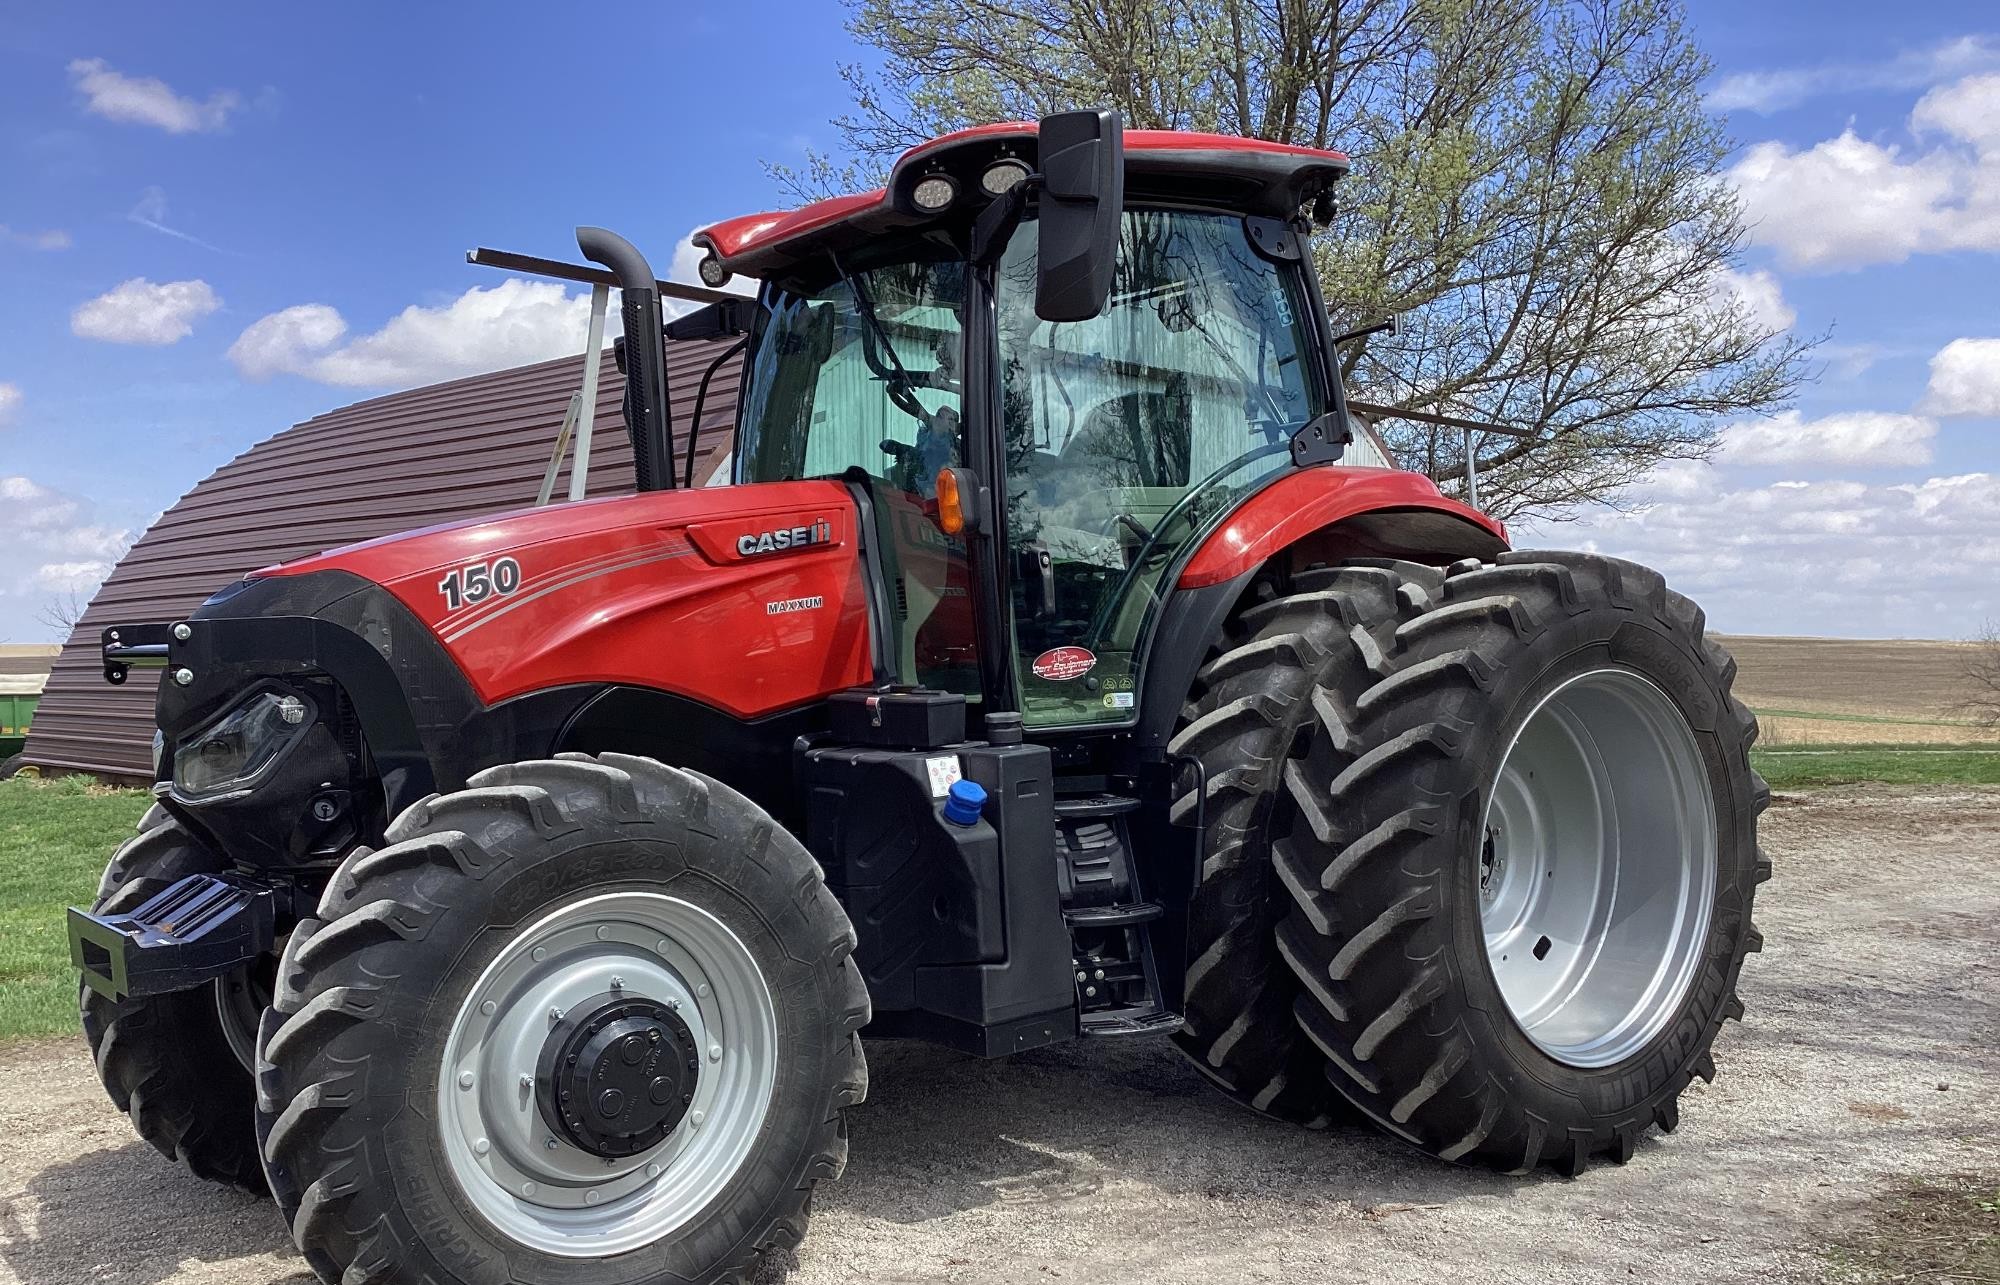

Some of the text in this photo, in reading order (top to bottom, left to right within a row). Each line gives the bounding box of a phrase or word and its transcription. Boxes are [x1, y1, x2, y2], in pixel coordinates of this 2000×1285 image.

[737, 526, 807, 555] CASE
[438, 556, 521, 612] 150
[767, 596, 823, 615] MAXXUM
[1600, 961, 1725, 1113] MICHELIN
